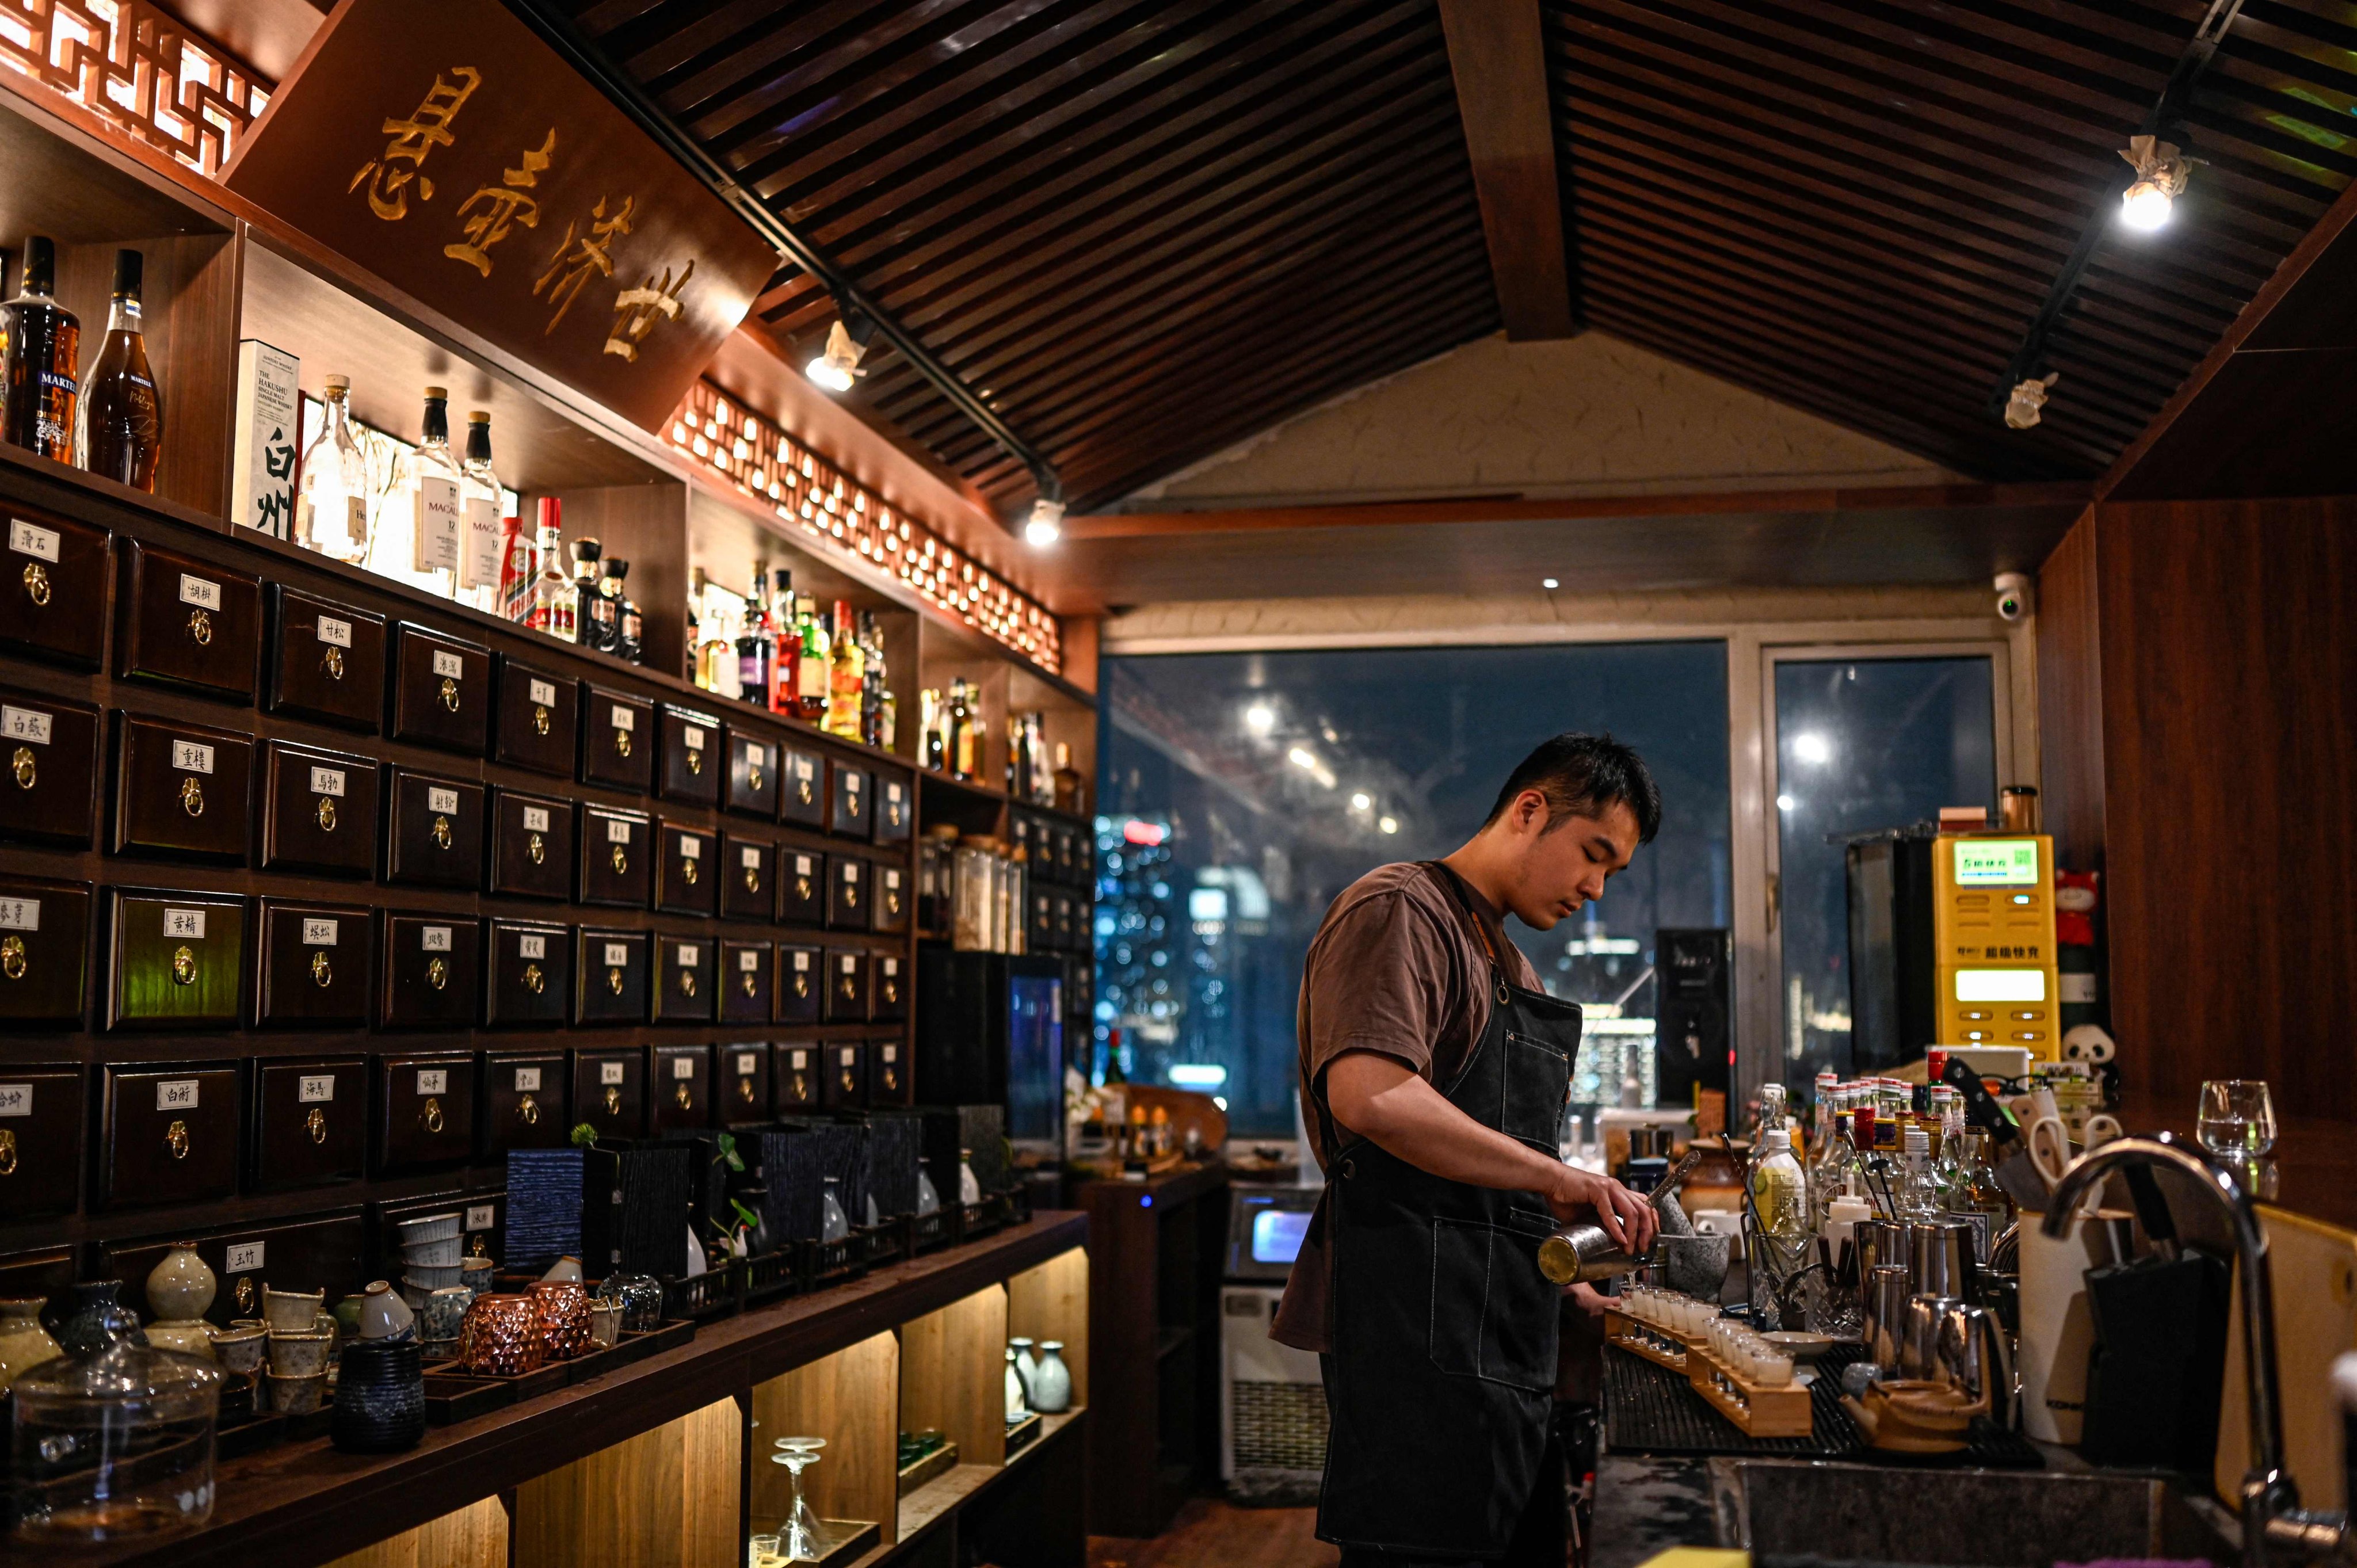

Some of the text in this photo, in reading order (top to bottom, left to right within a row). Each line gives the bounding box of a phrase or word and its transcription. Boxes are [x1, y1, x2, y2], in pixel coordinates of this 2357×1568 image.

[131, 375, 152, 387] MARTELL
[259, 370, 269, 379] THE
[258, 386, 284, 400] SINGLE MALT
[259, 377, 288, 395] HAKUSHU
[258, 392, 277, 404] JAPANESE
[278, 400, 292, 410] WHISKY
[257, 427, 295, 541] 白州
[448, 520, 455, 529] 12
[21, 529, 45, 550] 滑石
[492, 540, 498, 548] 12
[326, 623, 344, 639] 甘松
[318, 774, 337, 791] 馬勃
[167, 1086, 190, 1102] 白術
[306, 1082, 324, 1096] 海馬
[235, 1249, 254, 1266] 玉竹
